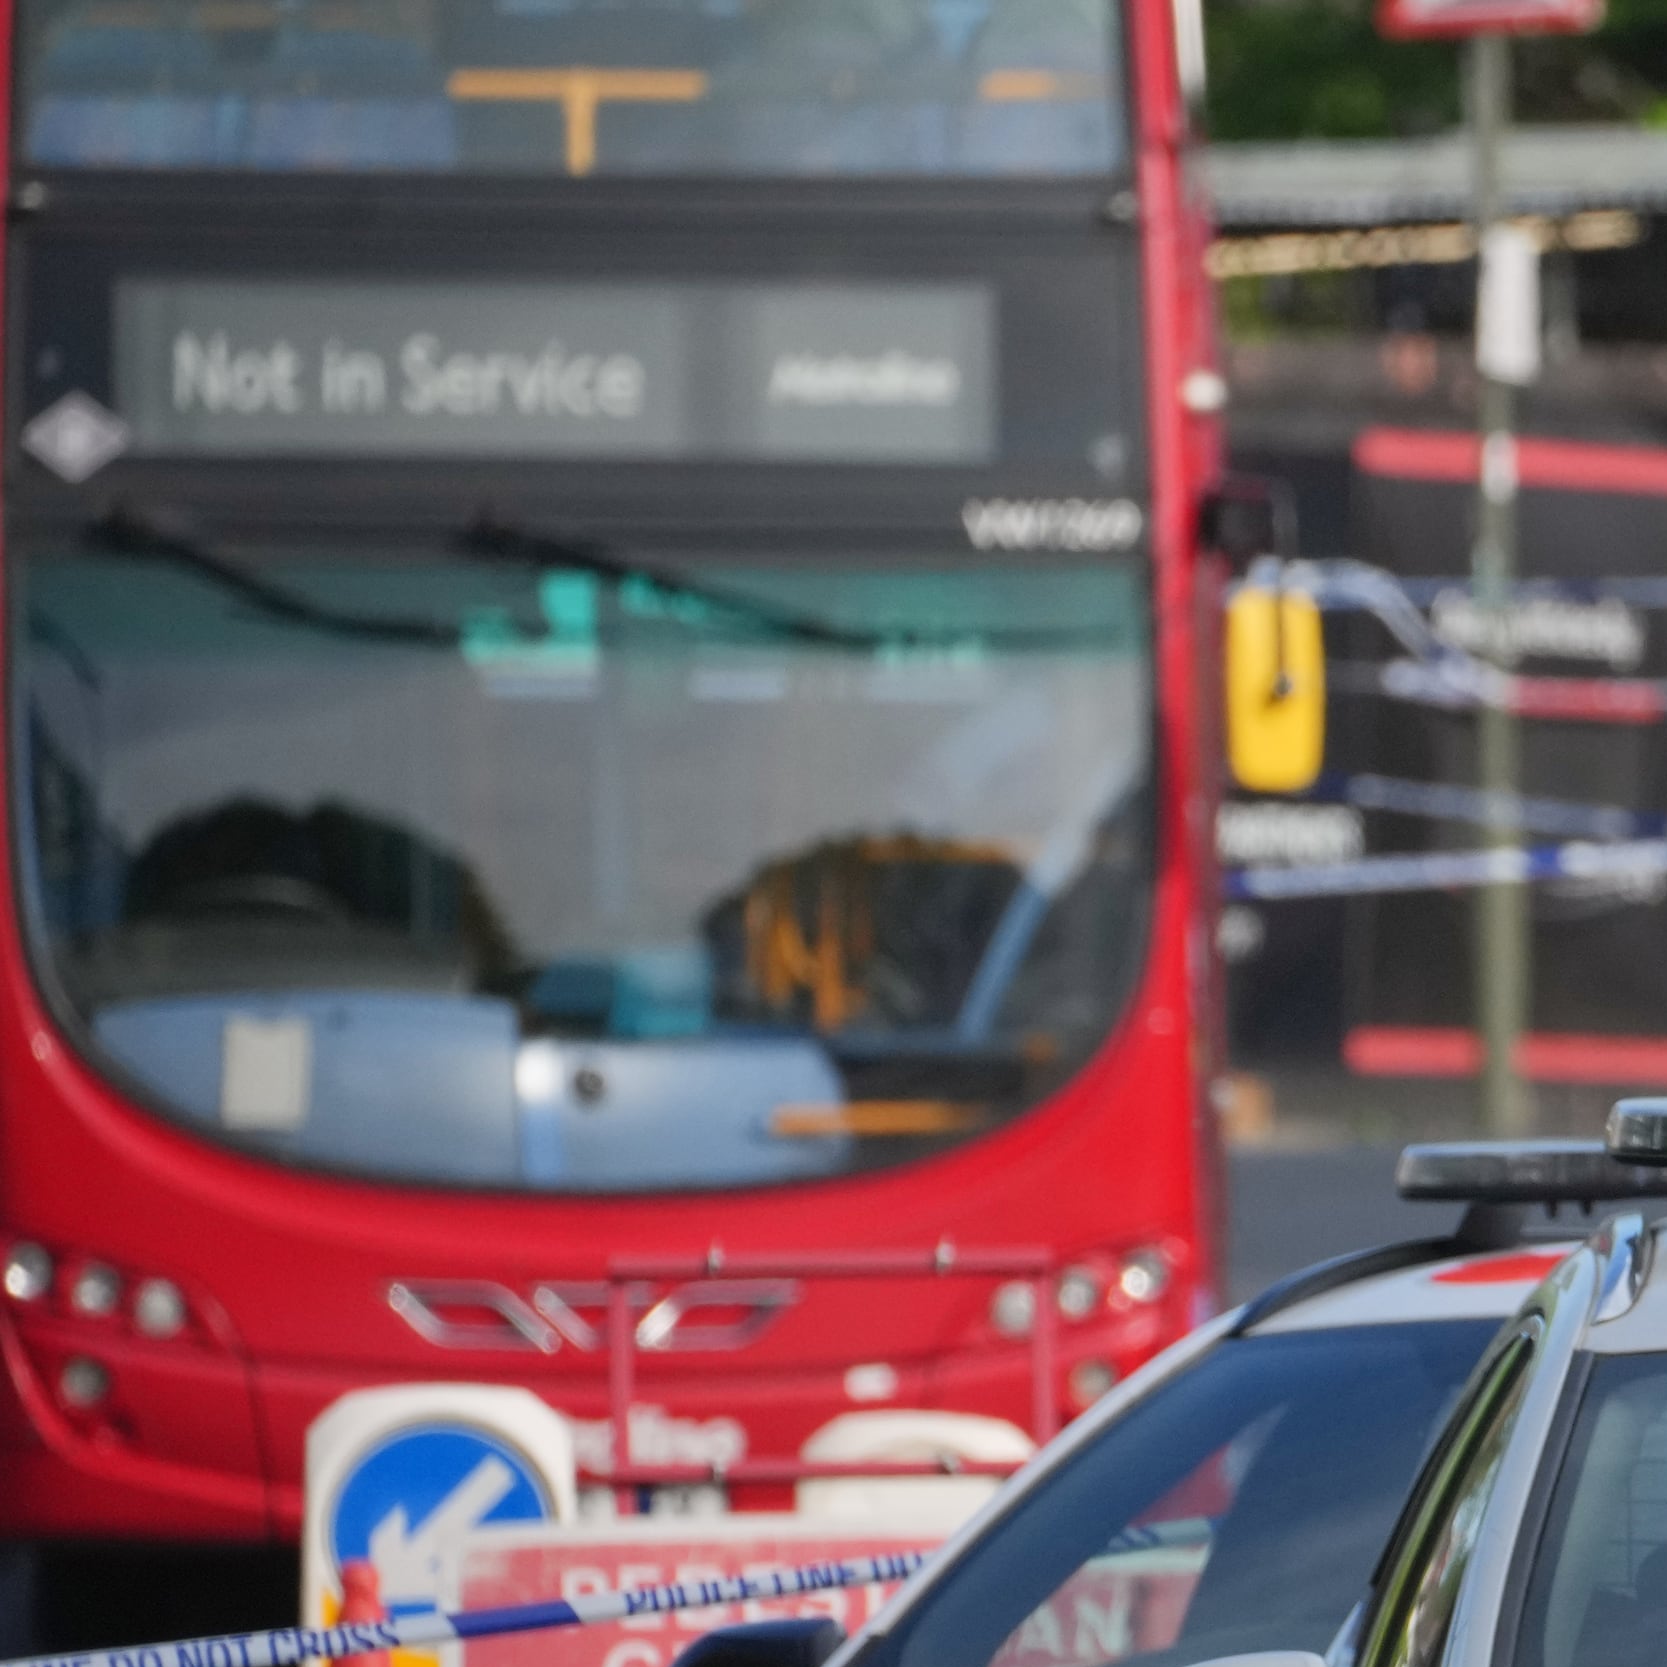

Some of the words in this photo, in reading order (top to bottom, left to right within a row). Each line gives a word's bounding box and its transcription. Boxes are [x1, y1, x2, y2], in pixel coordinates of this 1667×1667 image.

[173, 328, 298, 415] Not
[320, 334, 388, 415] in
[402, 331, 646, 418] Service
[770, 1562, 855, 1596] LINE
[268, 1622, 401, 1666] CROSS
